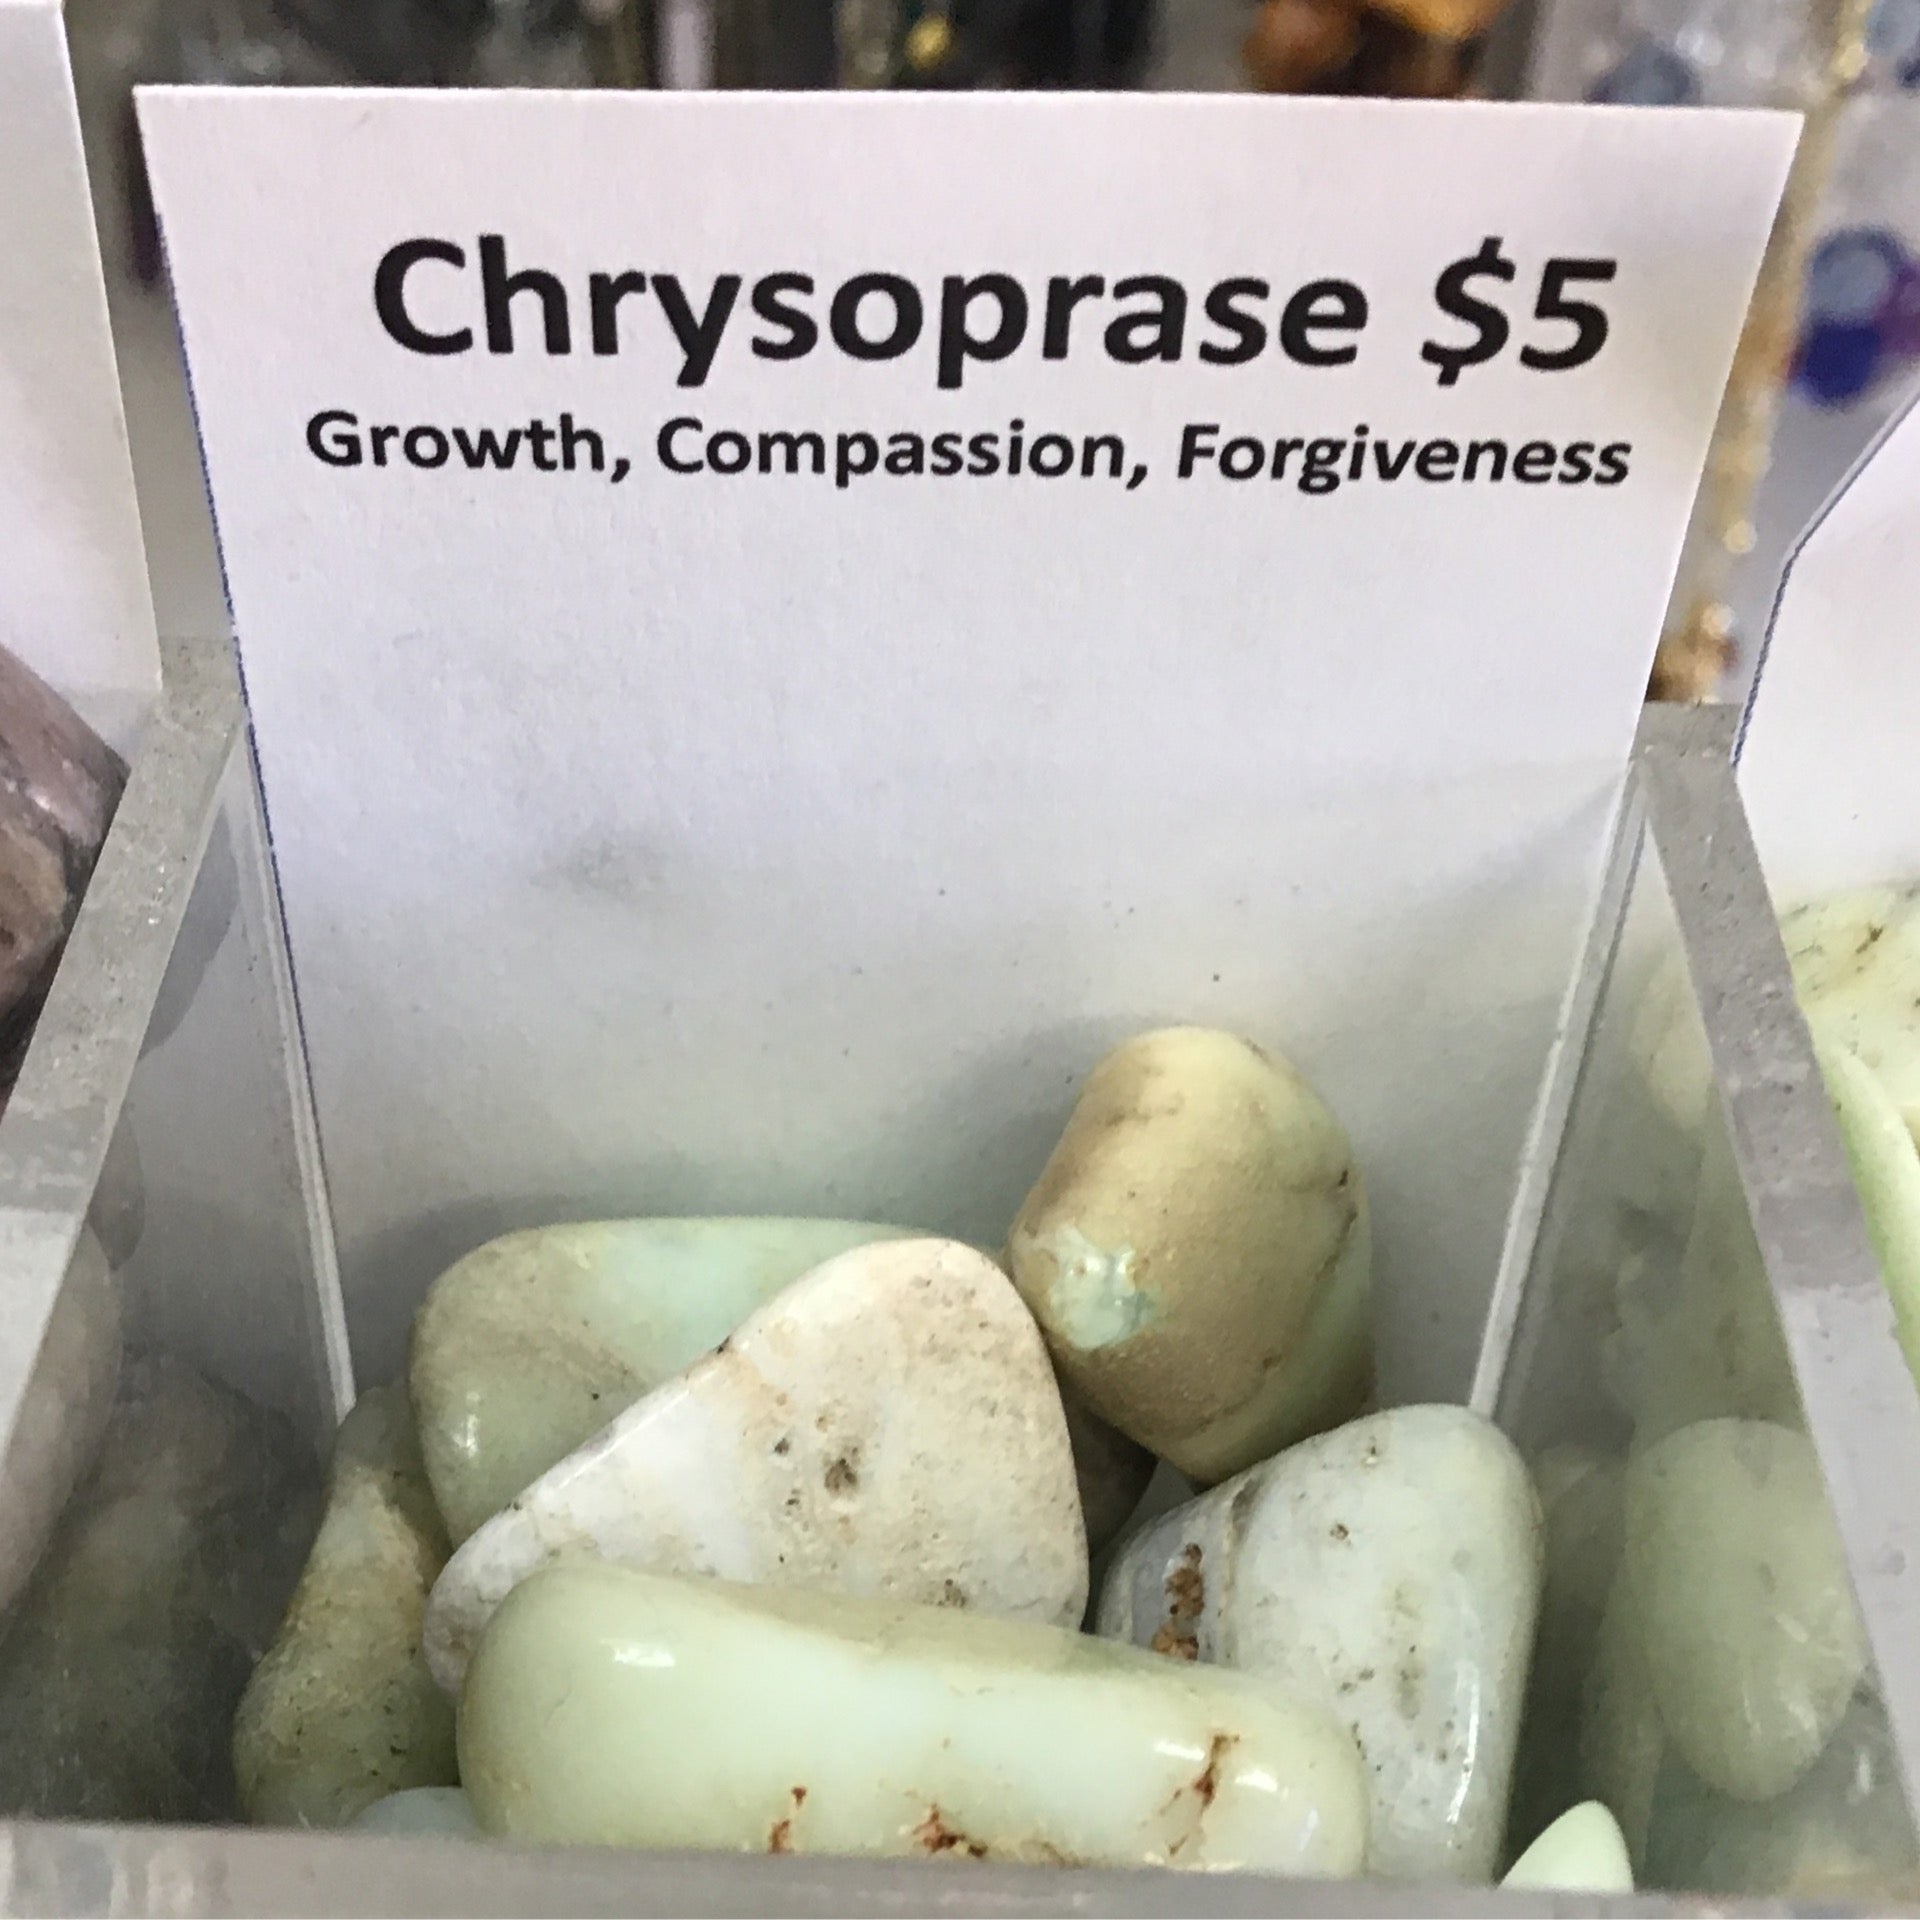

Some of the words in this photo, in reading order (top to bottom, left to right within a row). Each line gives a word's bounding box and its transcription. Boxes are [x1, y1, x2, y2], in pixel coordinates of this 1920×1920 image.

[373, 233, 1369, 390] Chrysoprase
[1420, 236, 1618, 386] $5
[306, 410, 632, 484] Growth,
[656, 417, 1149, 490] Compassion,
[1176, 424, 1632, 496] Forgiveness
